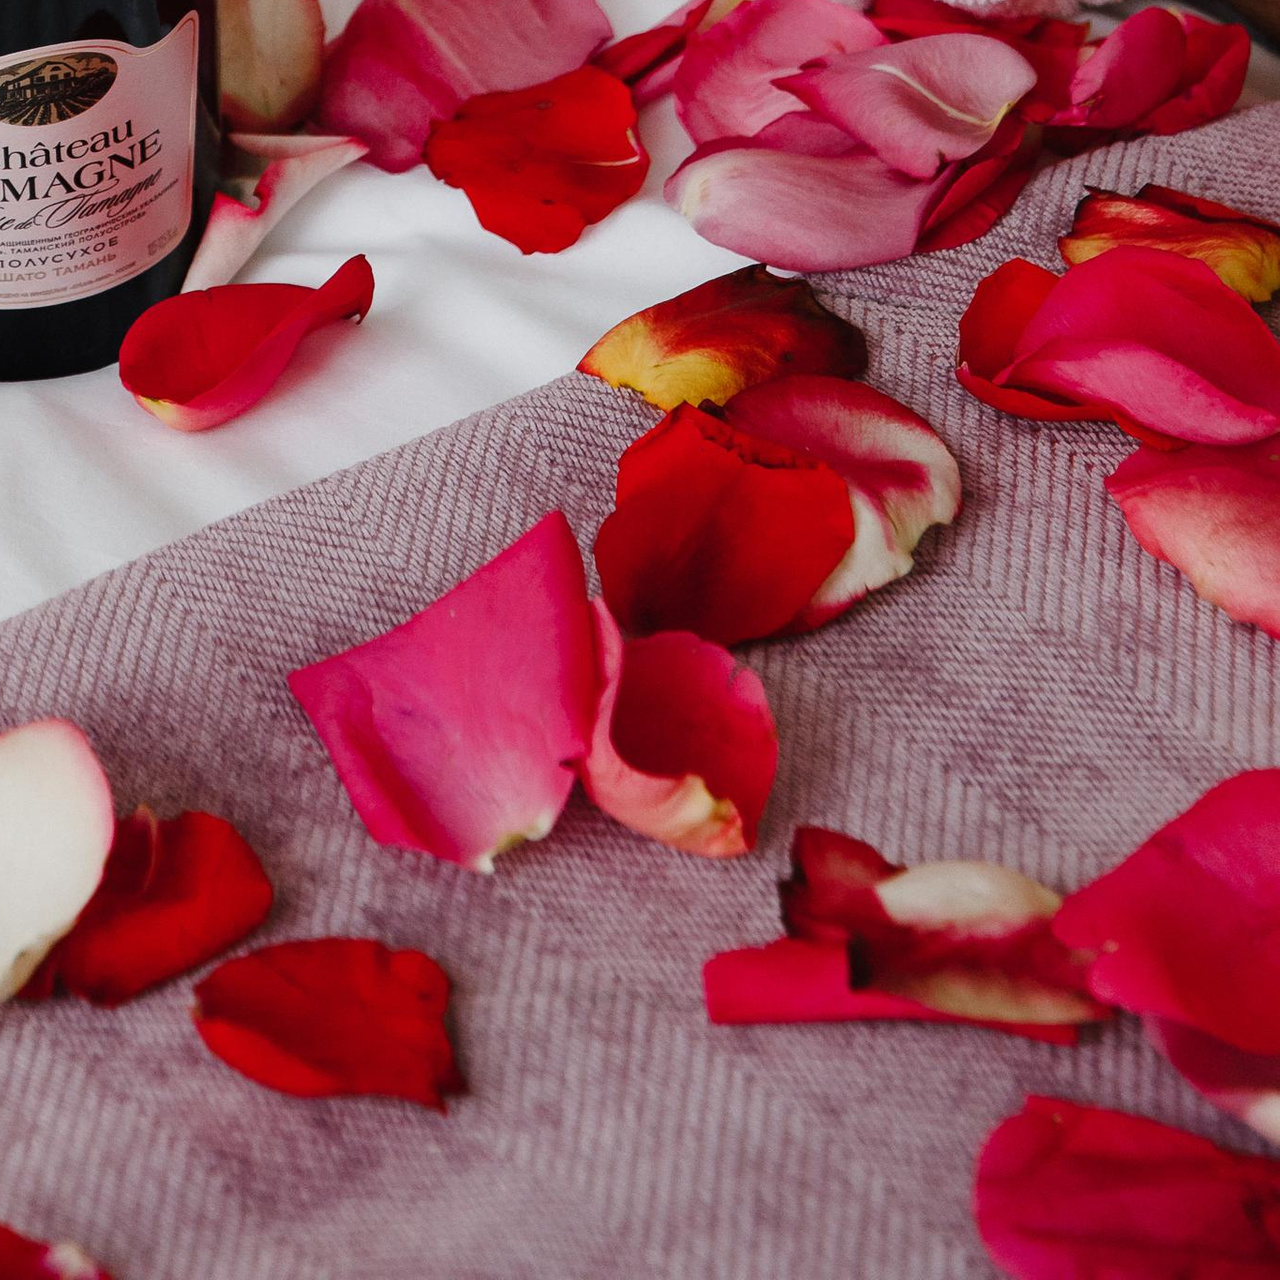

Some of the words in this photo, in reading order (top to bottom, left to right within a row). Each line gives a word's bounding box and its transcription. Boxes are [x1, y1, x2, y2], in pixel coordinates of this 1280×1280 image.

[34, 167, 163, 230] Tamagne
[10, 240, 75, 255] ТАМАНСКИЙ
[52, 253, 117, 278] ТАМАНЬ
